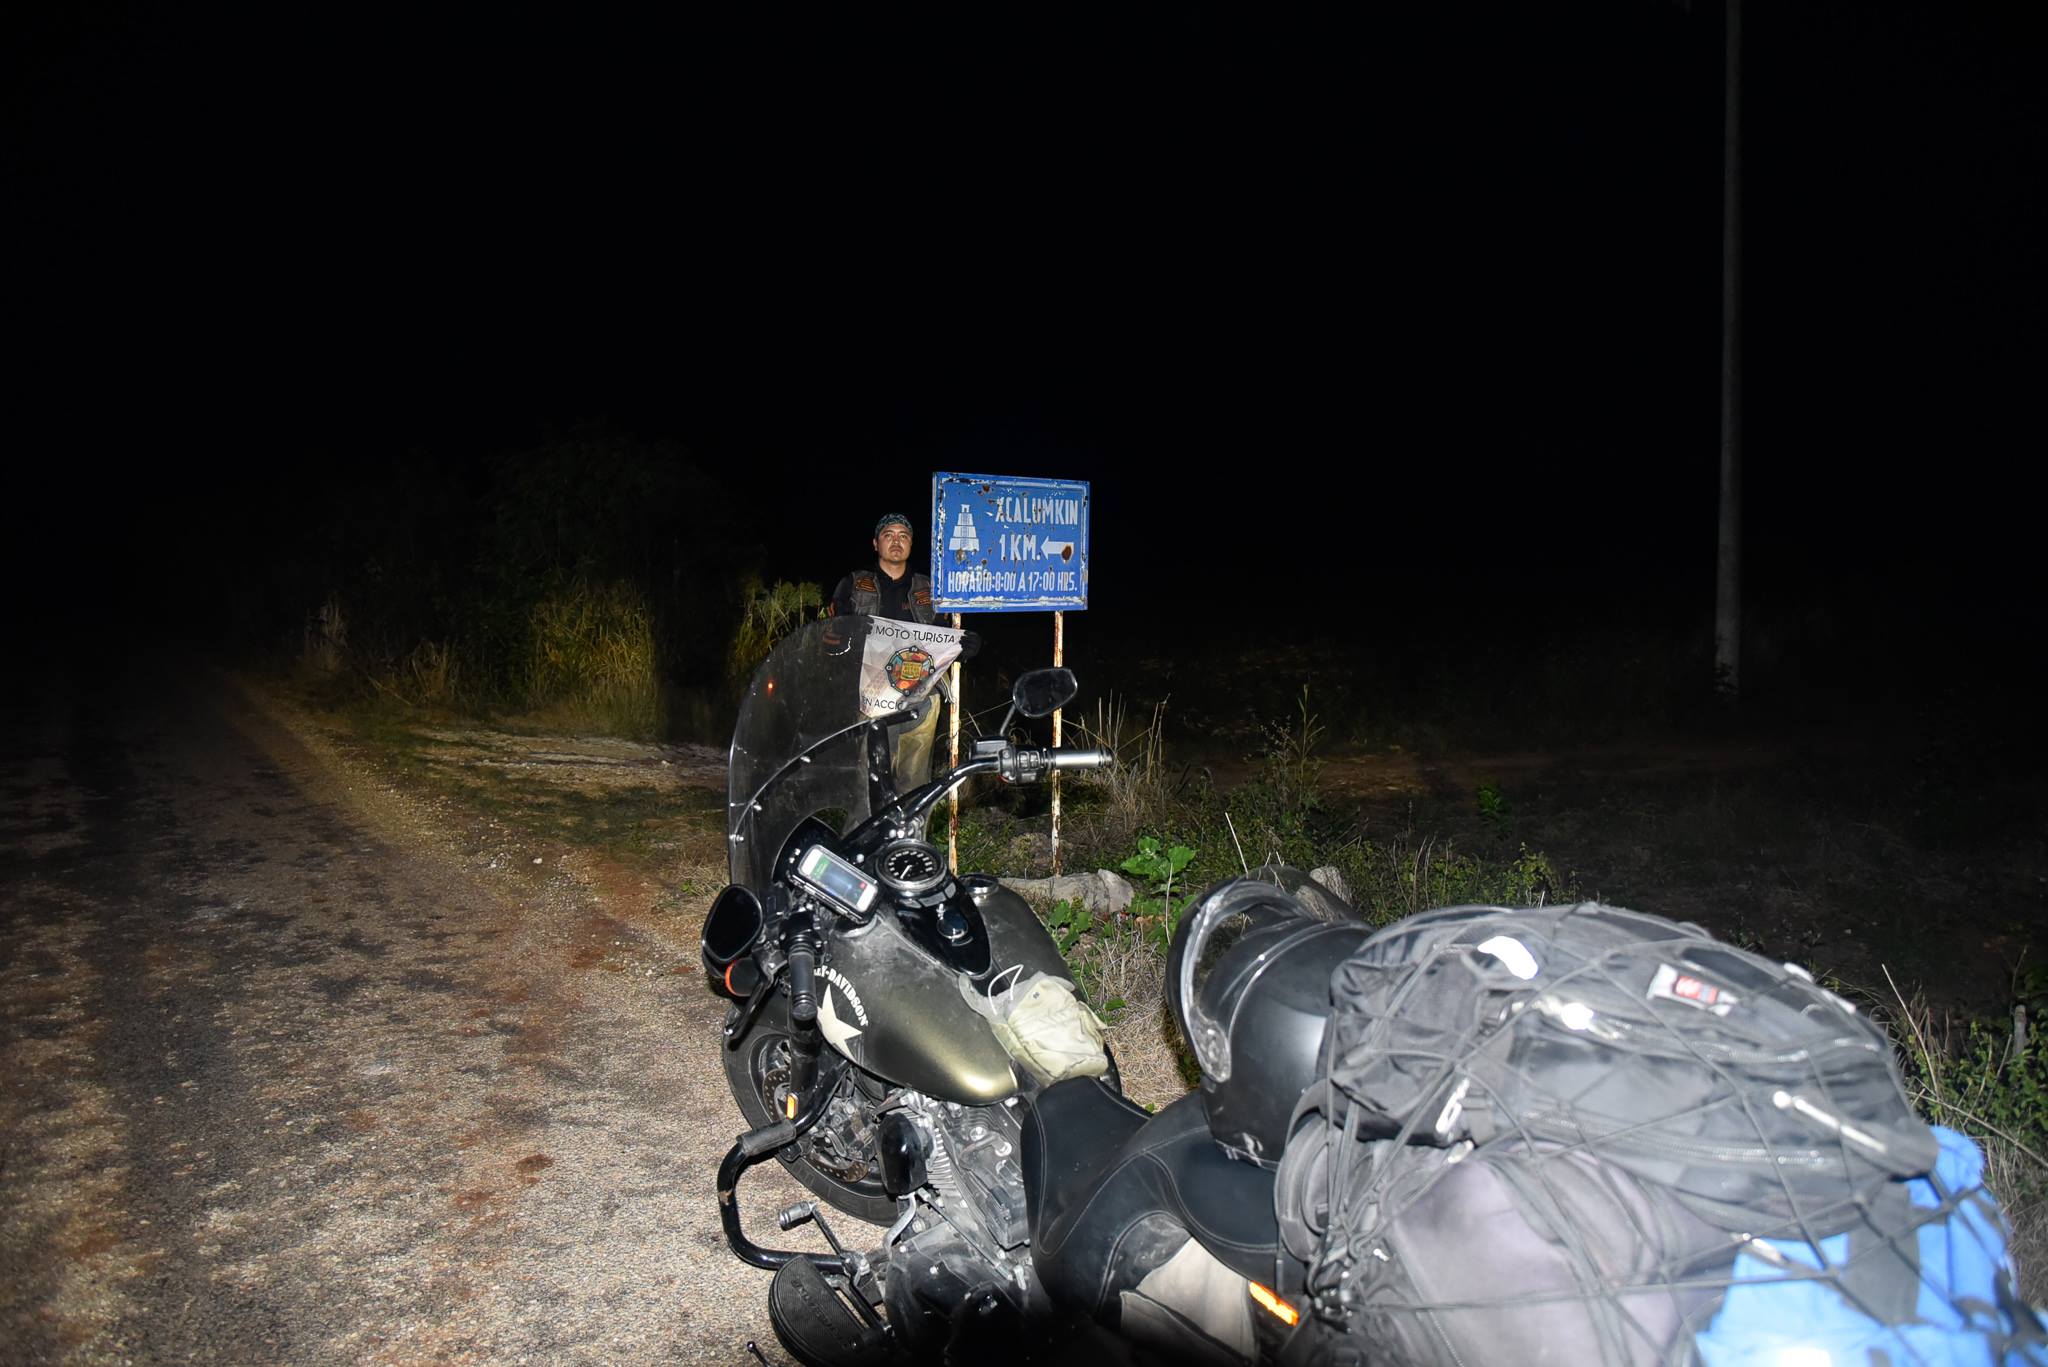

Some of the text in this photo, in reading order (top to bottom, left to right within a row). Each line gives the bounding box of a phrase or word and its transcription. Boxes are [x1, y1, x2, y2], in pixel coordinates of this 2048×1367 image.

[995, 496, 1078, 525] XCALUMKIN
[999, 534, 1040, 560] 1 KM.
[1018, 571, 1026, 592] A
[1028, 571, 1055, 592] 17:00
[1057, 571, 1077, 592] HRS.
[875, 625, 955, 643] MOTO TURISTA
